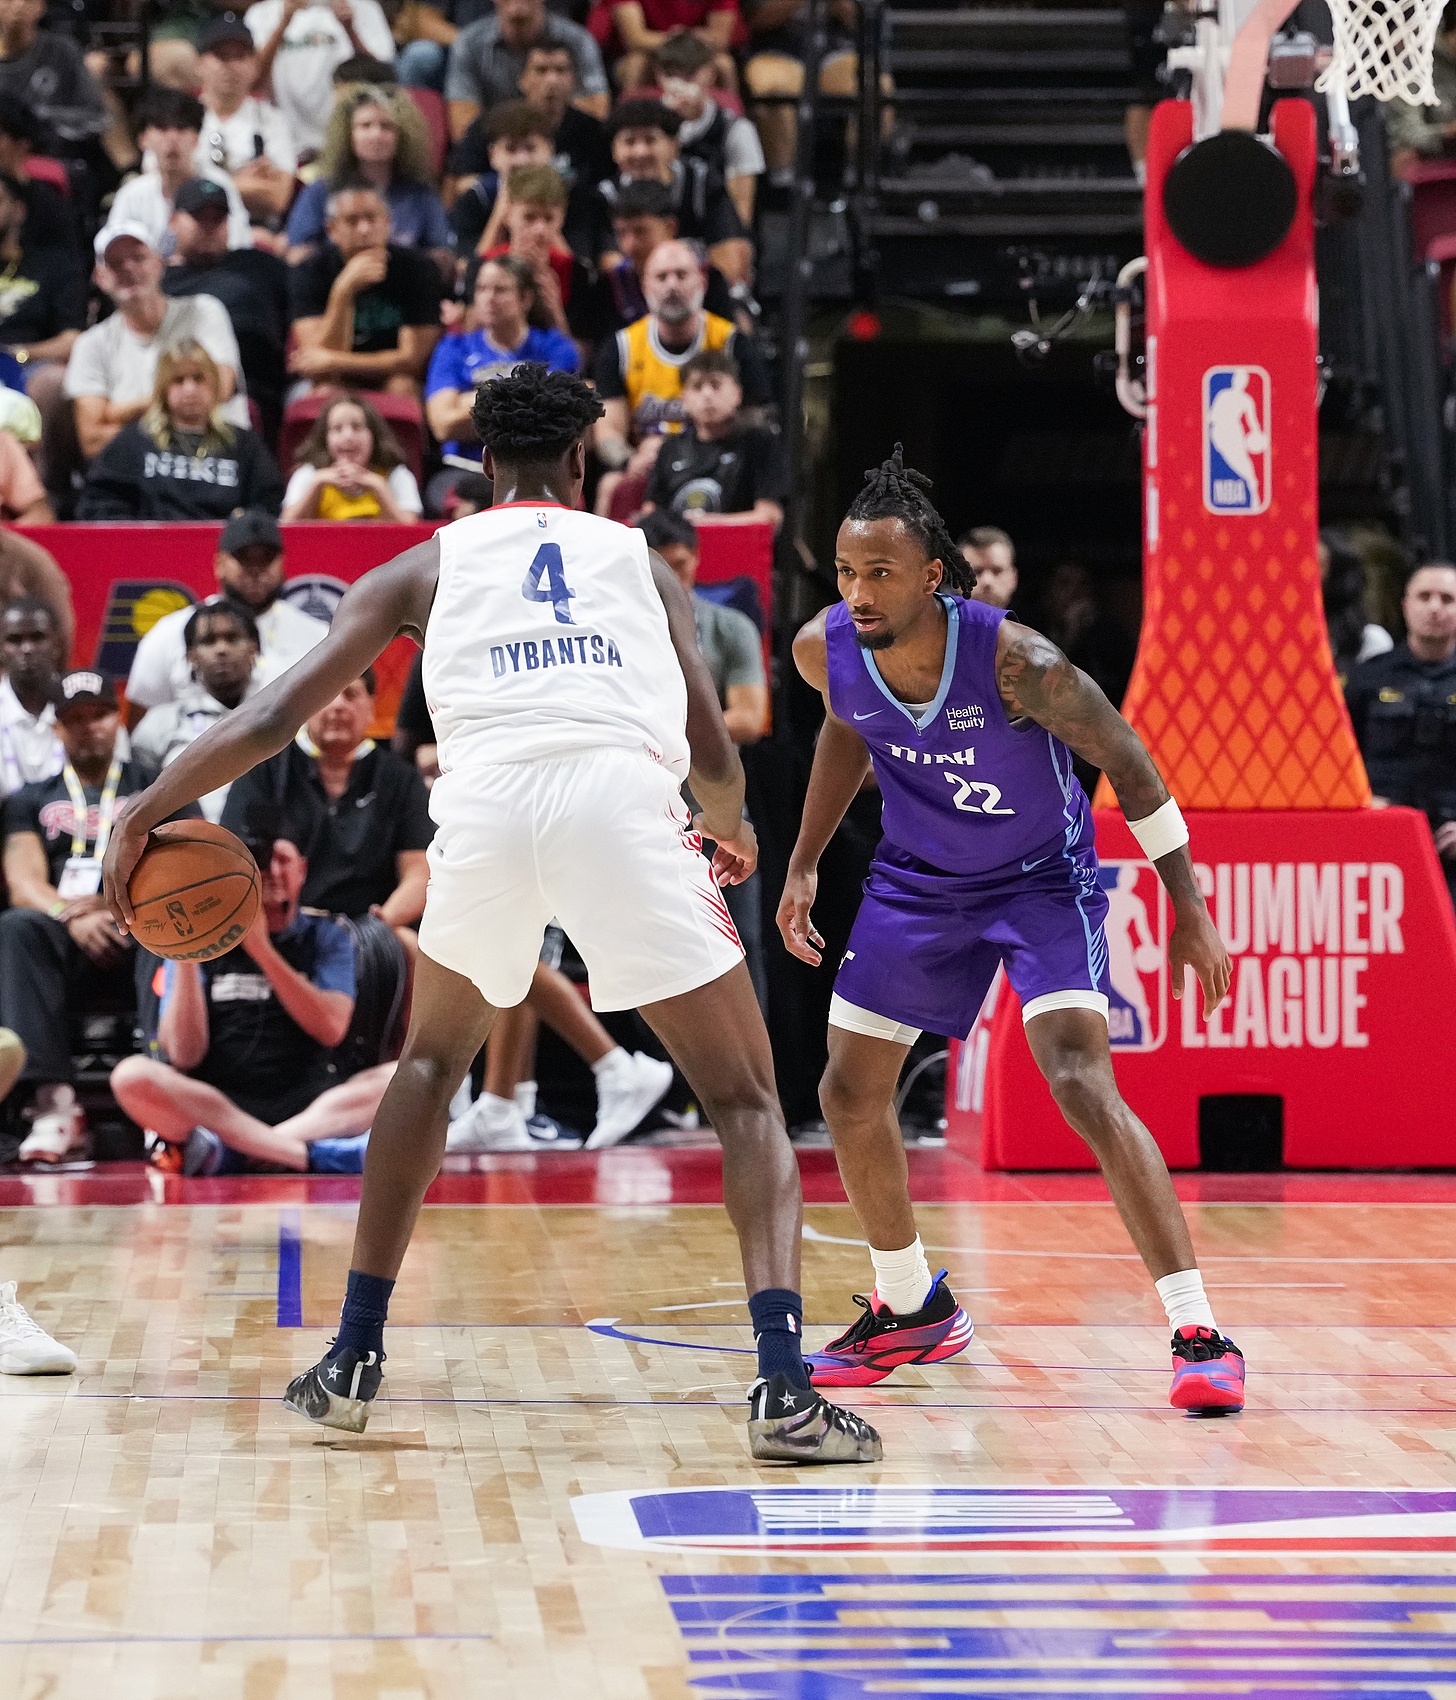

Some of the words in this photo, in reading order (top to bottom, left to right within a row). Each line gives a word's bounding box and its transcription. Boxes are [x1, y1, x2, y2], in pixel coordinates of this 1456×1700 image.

[144, 452, 239, 487] NIKE
[521, 542, 578, 626] 4
[489, 634, 623, 679] DYBANTSA
[946, 704, 983, 720] Health
[949, 716, 985, 731] Equity
[943, 771, 1016, 815] 22
